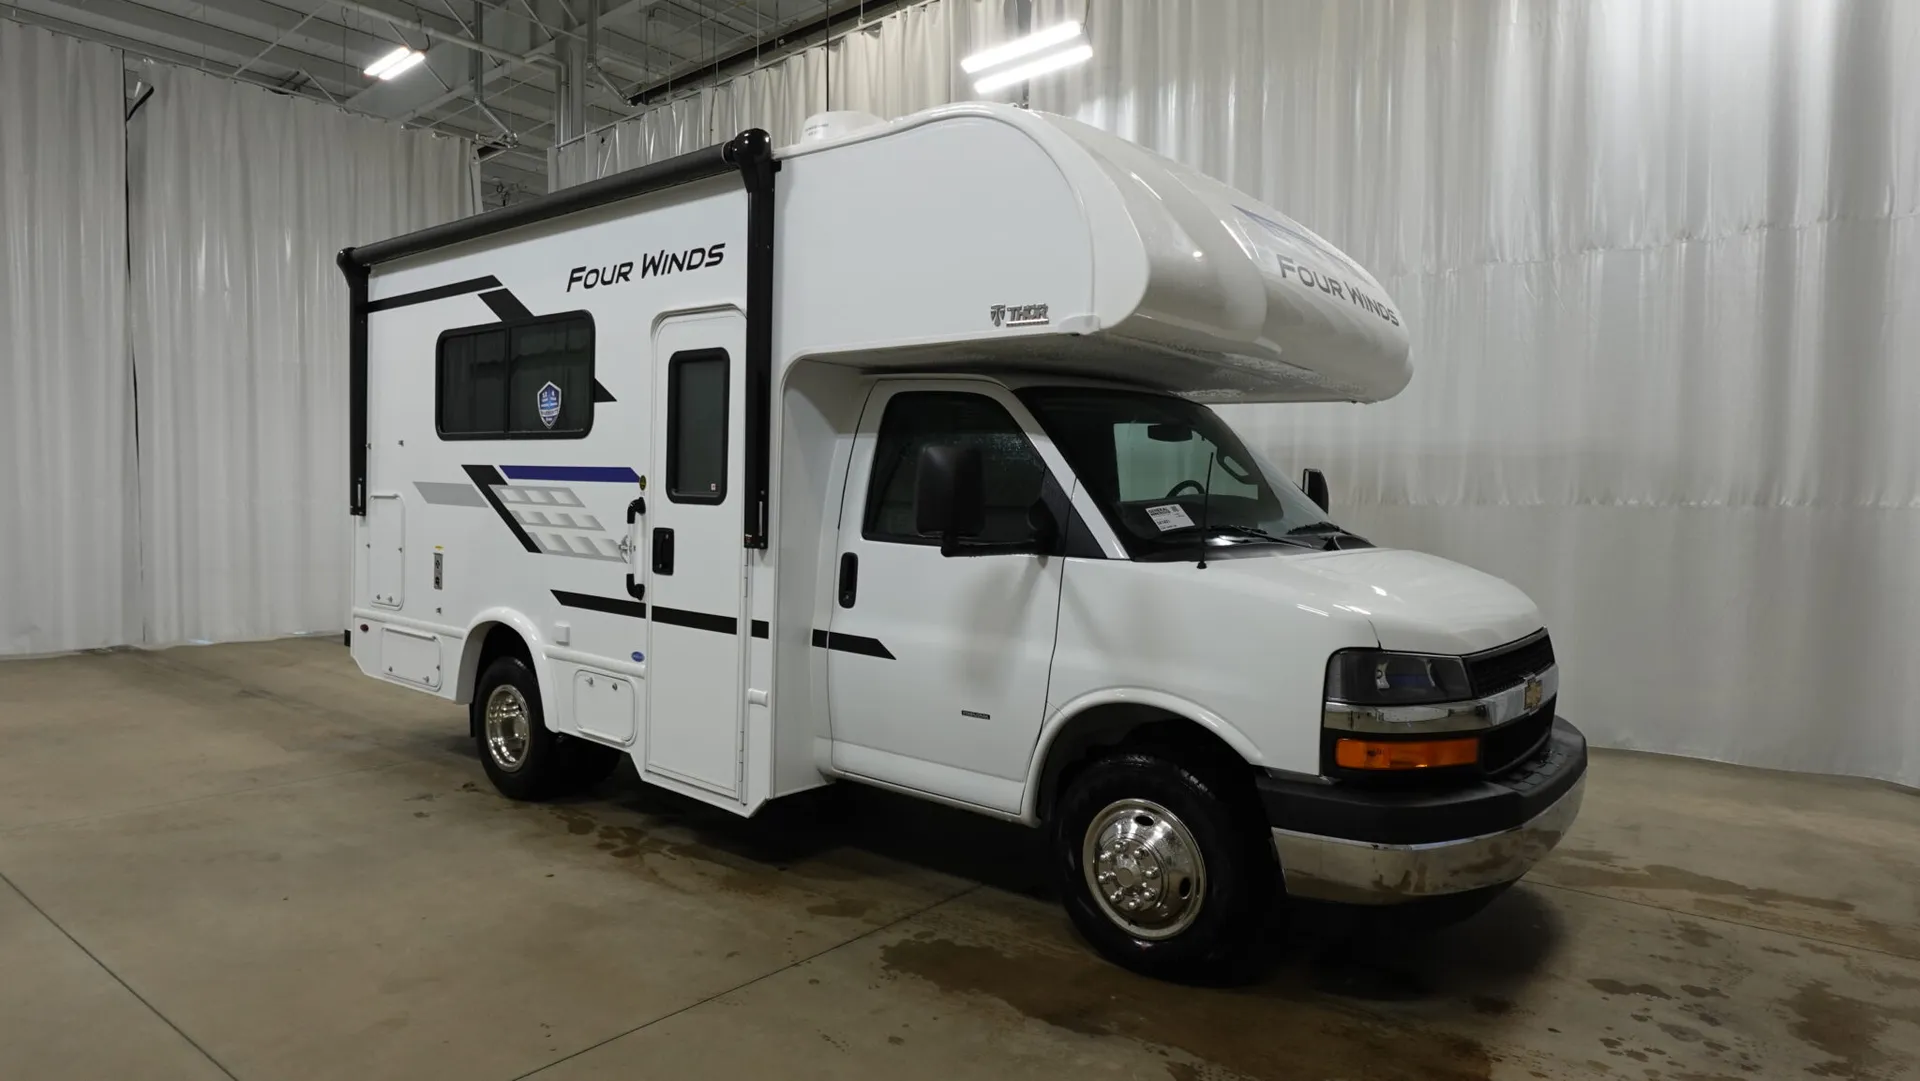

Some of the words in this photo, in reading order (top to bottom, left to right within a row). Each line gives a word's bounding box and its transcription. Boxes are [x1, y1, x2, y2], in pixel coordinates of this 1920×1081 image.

[566, 261, 634, 293] FOUR
[641, 243, 726, 279] WINDS
[1276, 253, 1346, 300] FOUR
[1343, 281, 1399, 327] WINDS
[1007, 303, 1049, 322] THOR
